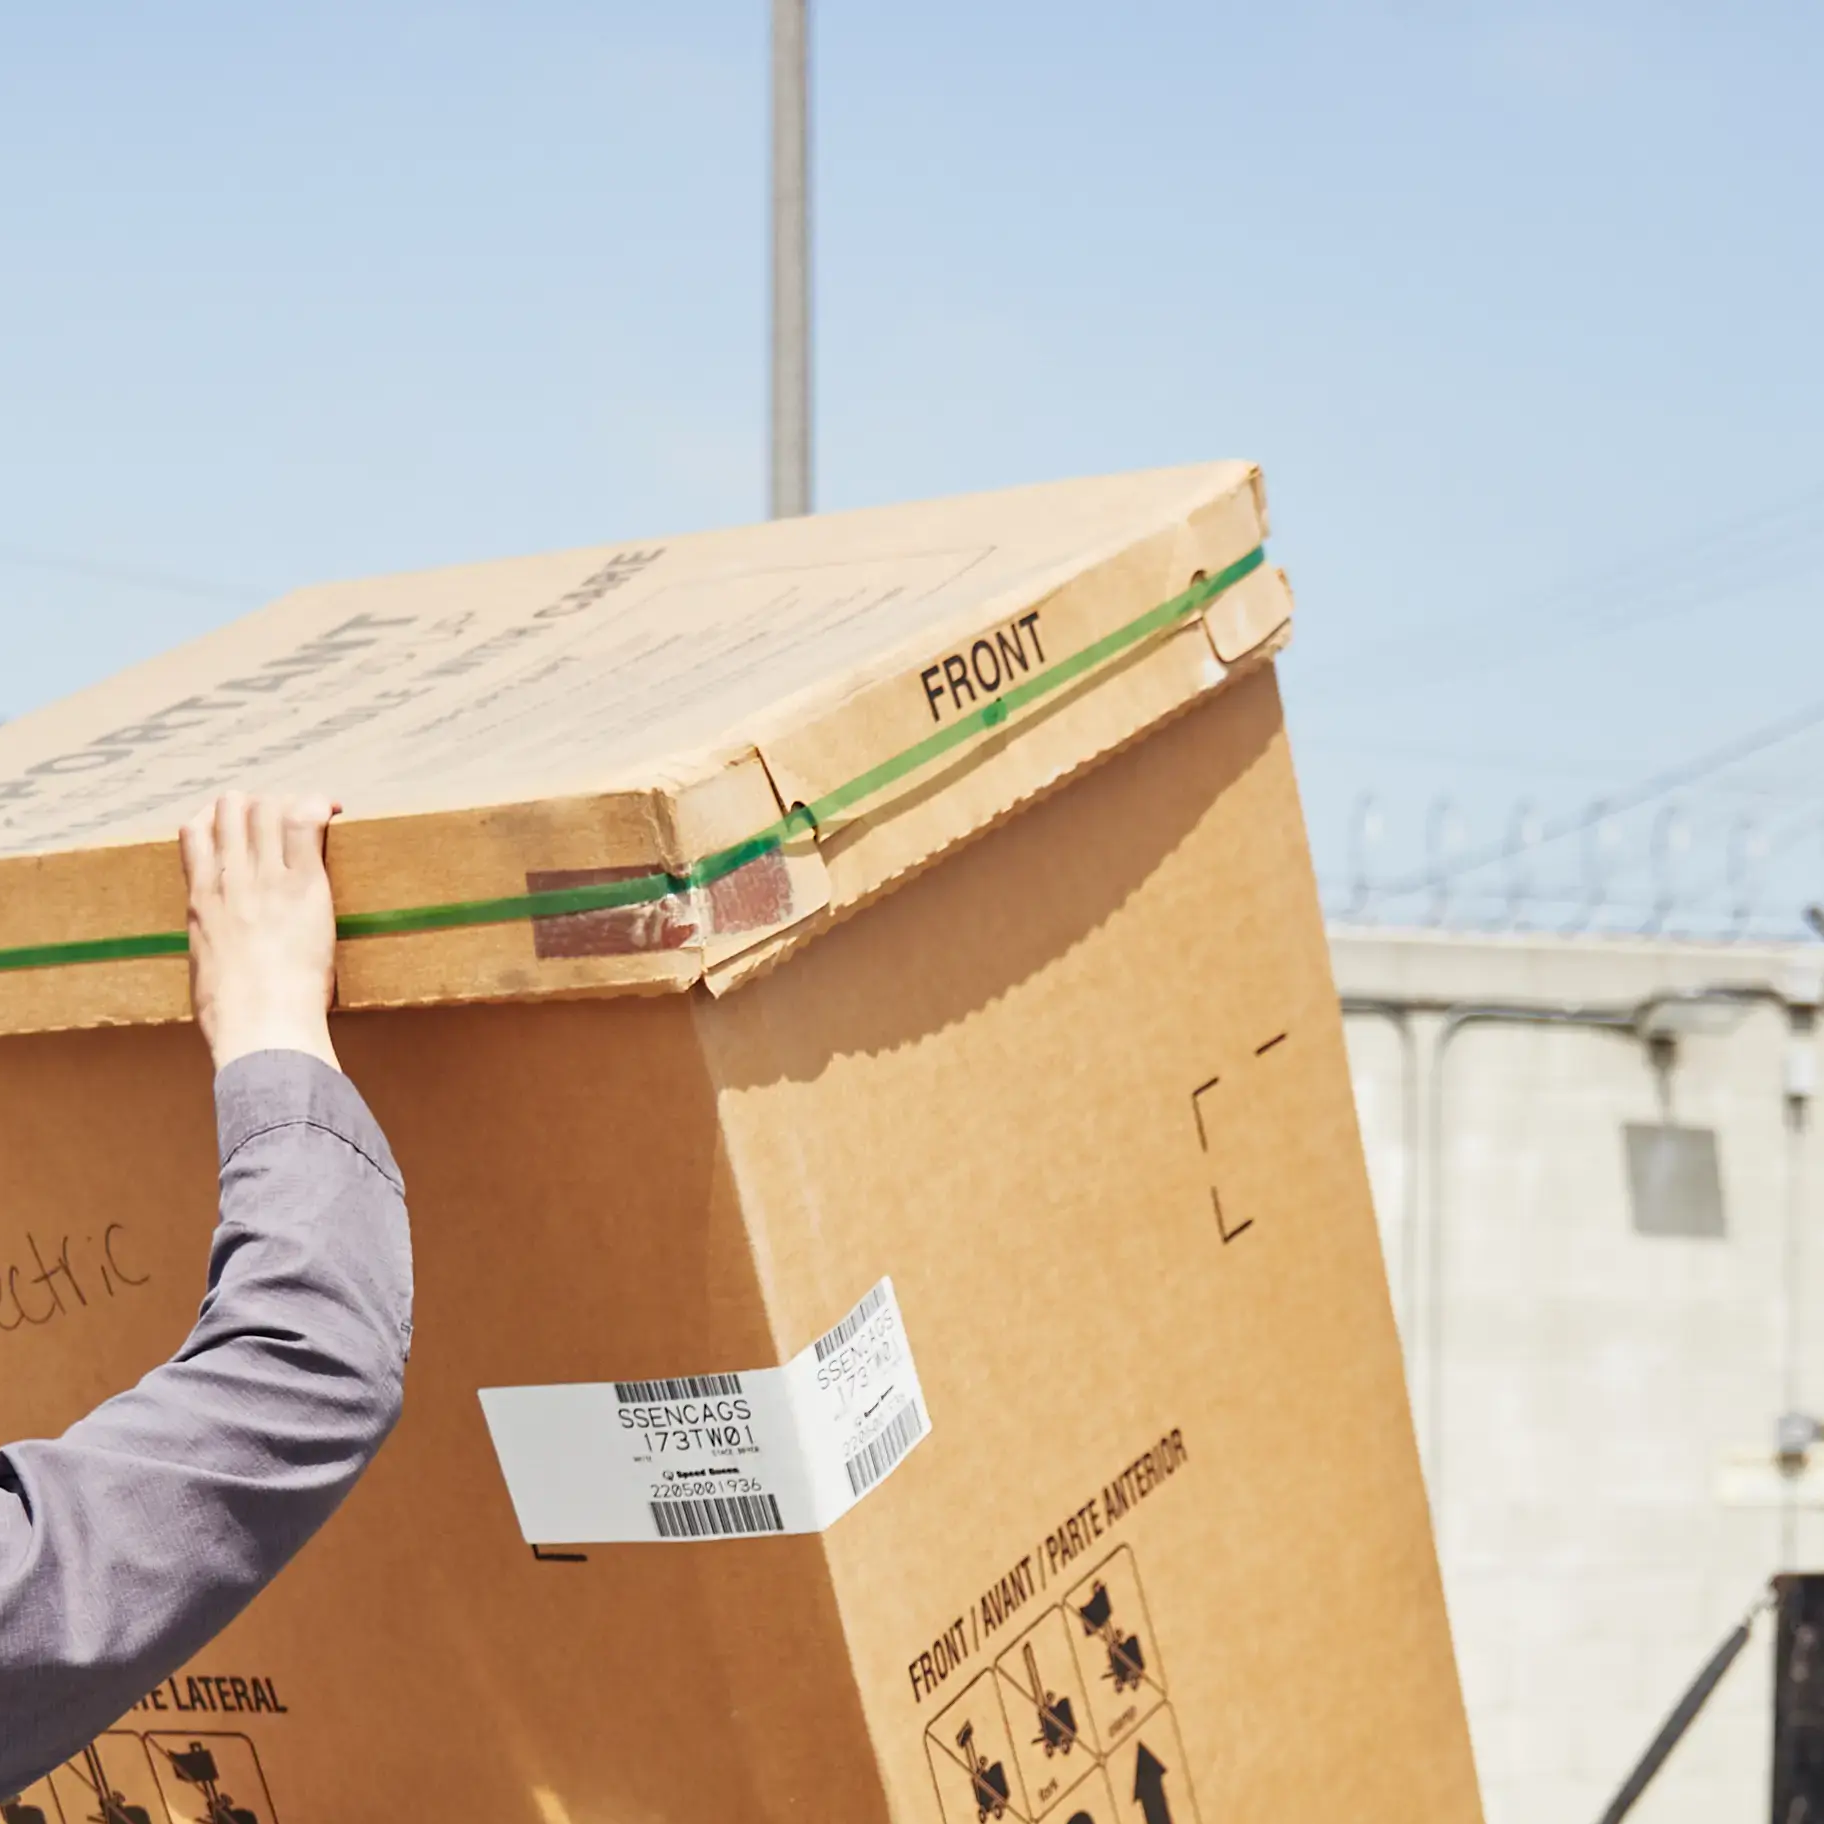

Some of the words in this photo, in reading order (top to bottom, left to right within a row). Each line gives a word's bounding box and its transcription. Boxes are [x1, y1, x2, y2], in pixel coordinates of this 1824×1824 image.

[529, 546, 667, 620] CARE
[920, 611, 1046, 722] FRONT
[617, 1399, 752, 1430] SSENCAGS
[643, 1425, 755, 1452] 173TW01
[676, 1468, 706, 1479] Speed
[907, 1616, 969, 1704] FRONT
[980, 1554, 1036, 1638] AVANT
[1044, 1498, 1104, 1576] PARTE
[1102, 1428, 1189, 1528] ANTERIOR
[168, 1674, 288, 1714] LATERAL
